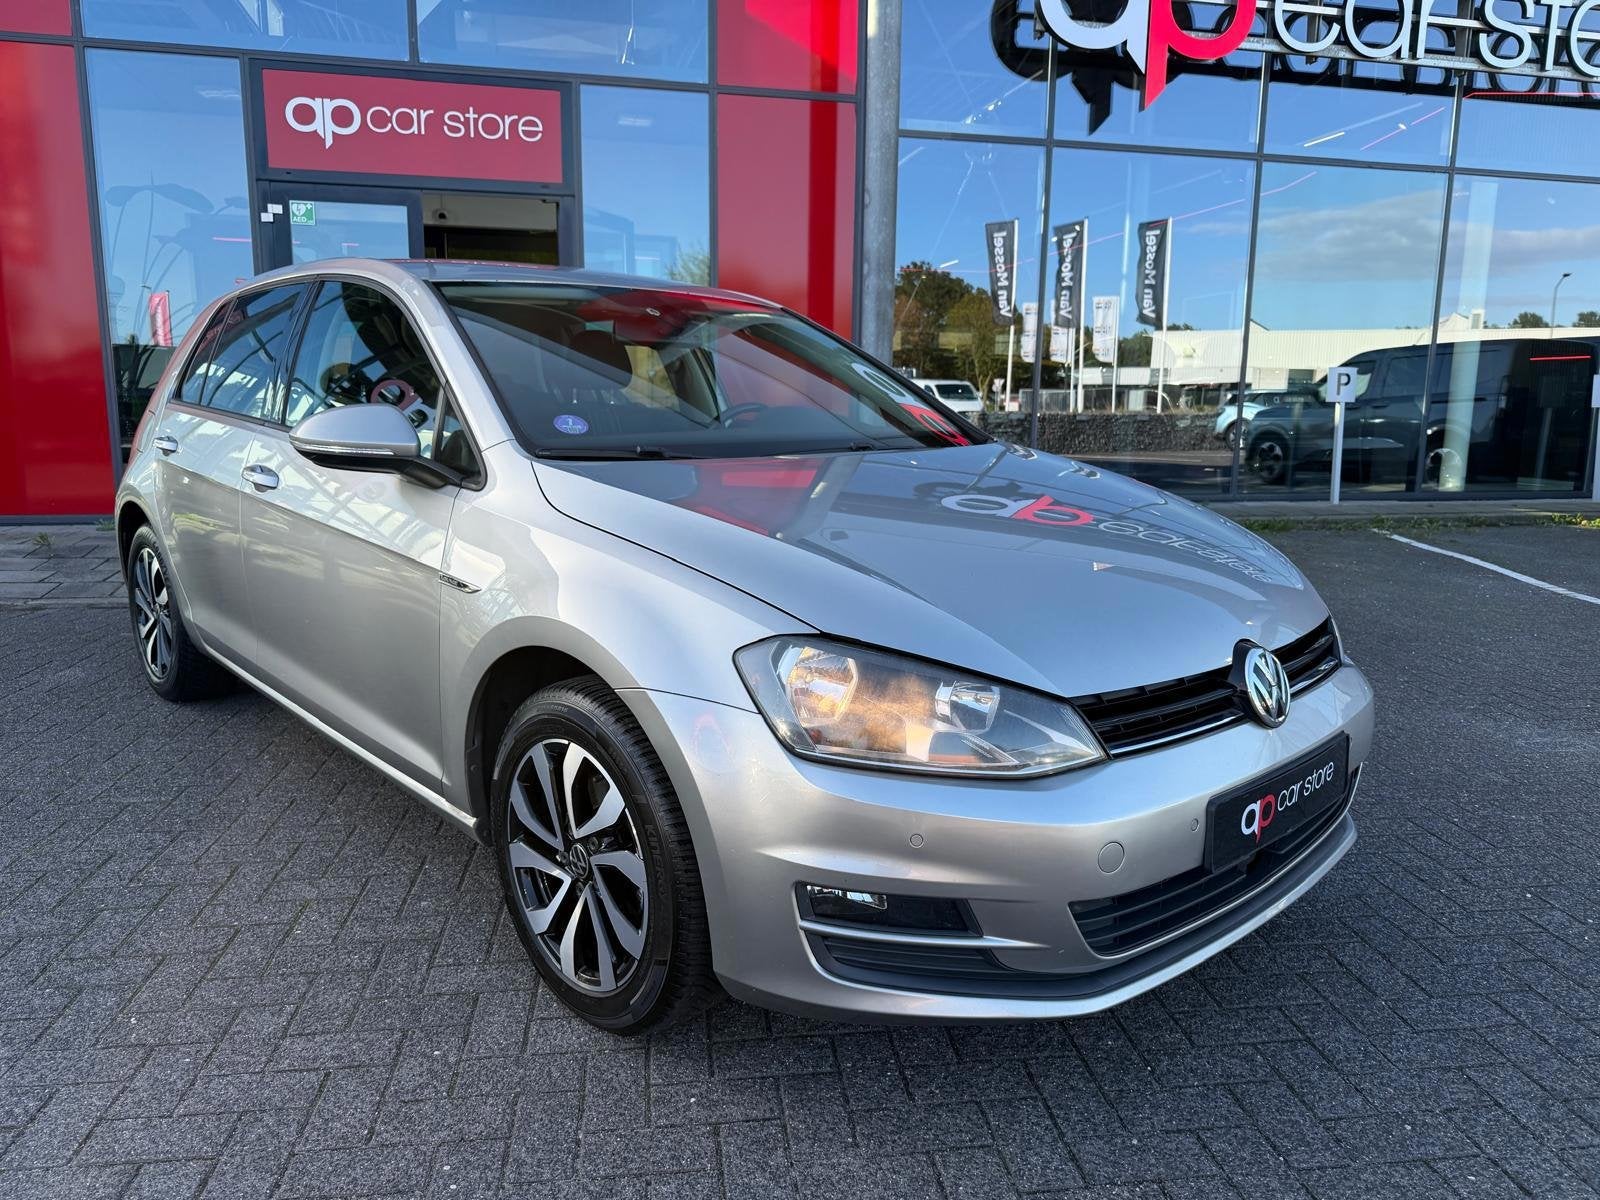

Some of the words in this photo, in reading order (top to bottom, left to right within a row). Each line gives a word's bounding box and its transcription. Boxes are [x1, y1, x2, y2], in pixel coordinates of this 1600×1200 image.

[285, 96, 361, 149] ap
[366, 106, 434, 134] car
[443, 106, 543, 142] store
[1336, 373, 1351, 396] P
[1241, 794, 1276, 844] ap
[1277, 781, 1302, 811] car
[1303, 761, 1334, 796] store
